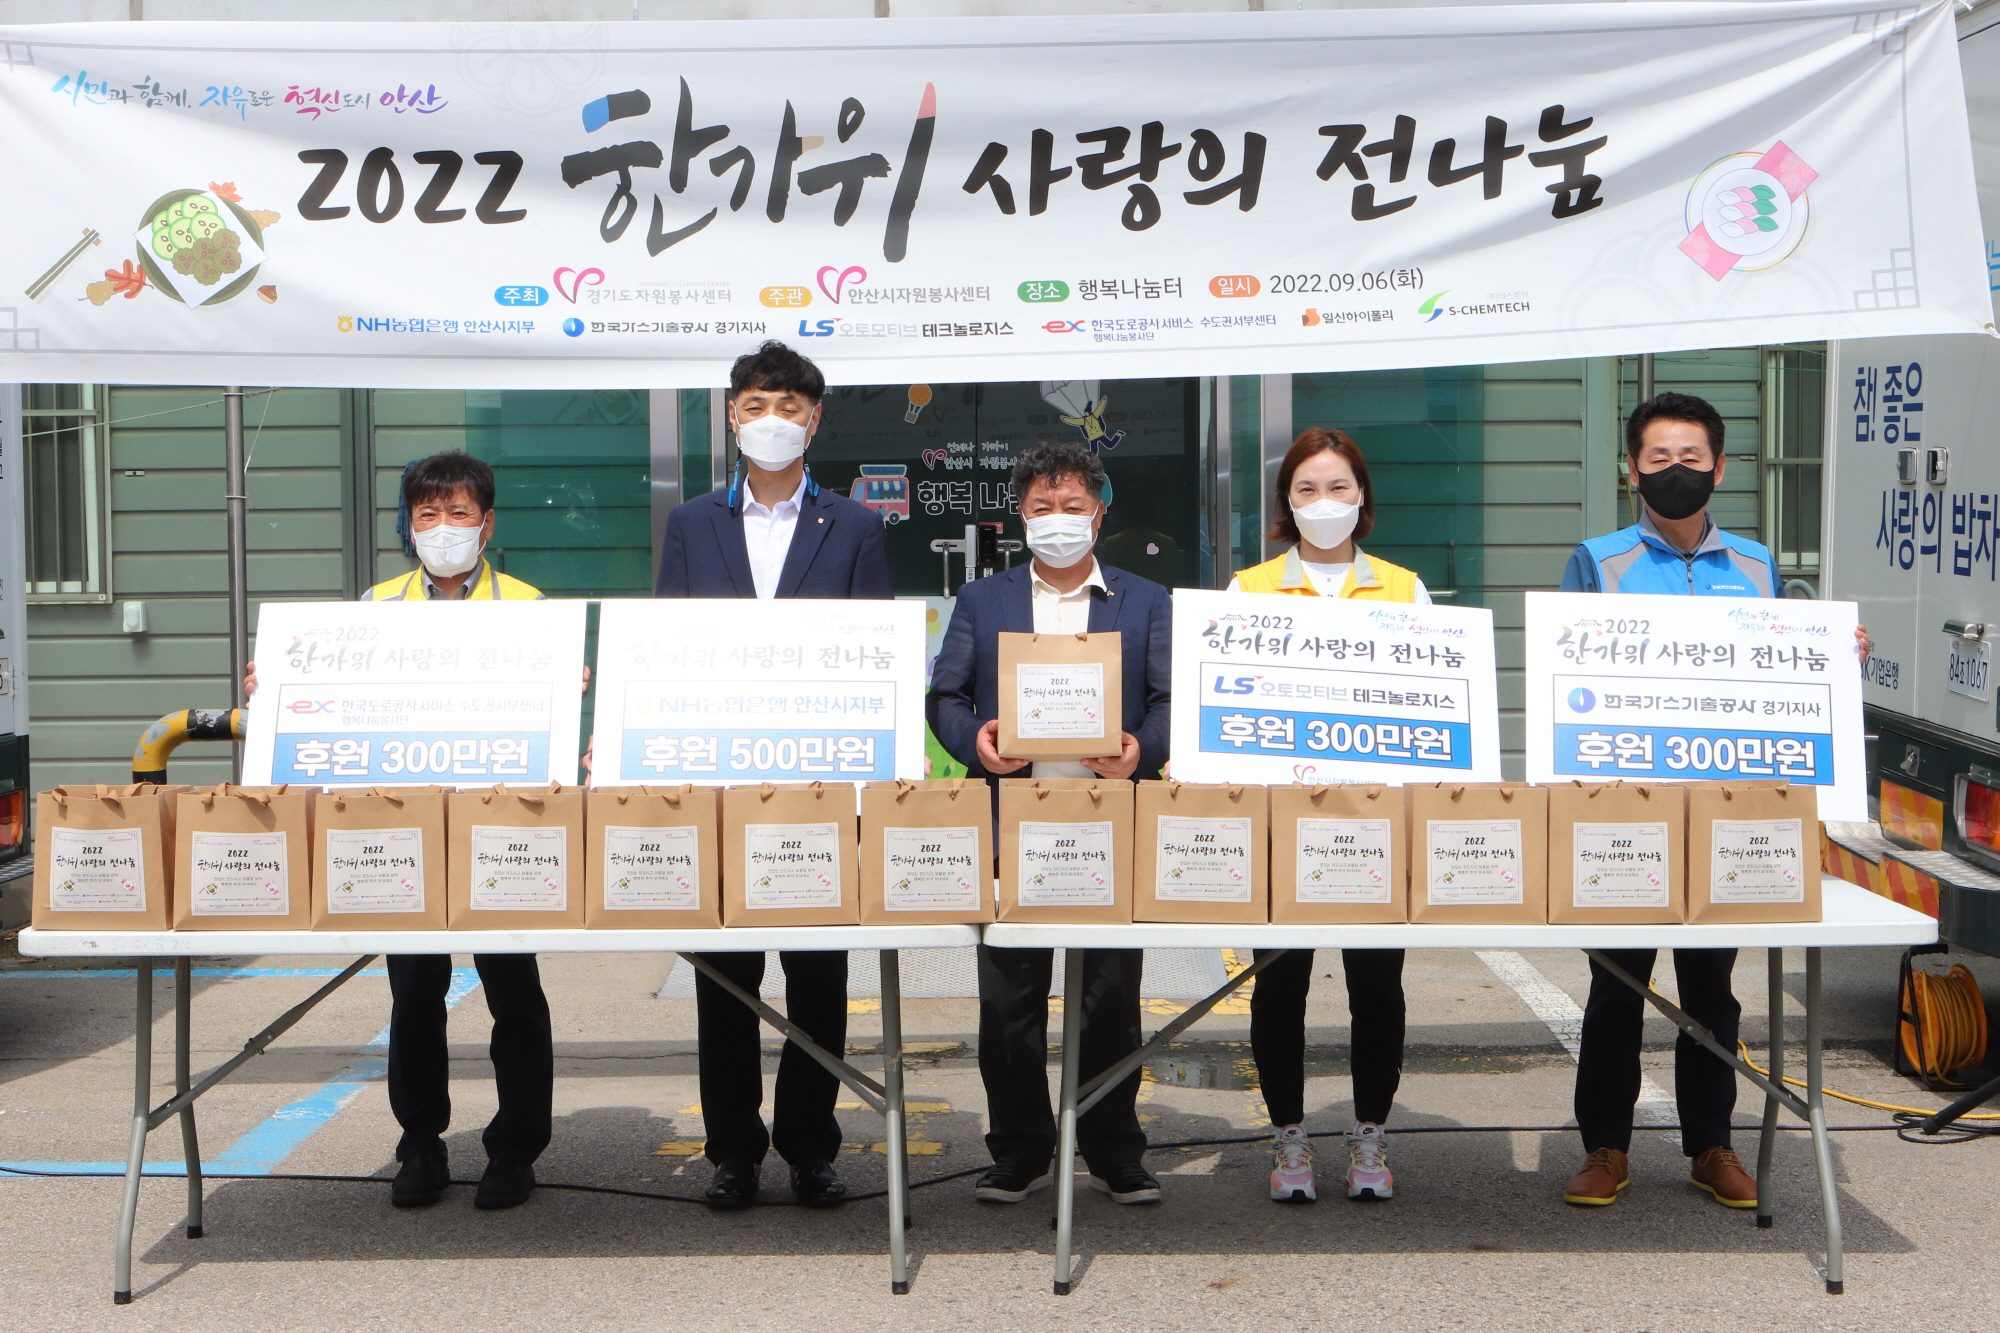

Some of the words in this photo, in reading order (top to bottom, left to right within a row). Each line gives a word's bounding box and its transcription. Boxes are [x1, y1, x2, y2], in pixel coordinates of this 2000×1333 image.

[51, 70, 132, 106] 시민과
[200, 85, 275, 121] 자유로운
[284, 85, 370, 121] 혁신도시
[379, 83, 449, 114] 안산
[297, 146, 527, 224] 2022
[561, 75, 936, 263] 한가위
[962, 120, 1267, 232] 사랑의
[1315, 104, 1608, 221] 전나눔
[503, 288, 540, 305] 주최
[586, 287, 732, 305] 경기도자원봉사센터
[767, 288, 804, 306] 주관
[847, 285, 991, 305] 안산시자원봉사센터
[1027, 281, 1062, 300] 장소
[1078, 277, 1183, 301] 행복나눔터
[1217, 278, 1252, 296] 일시
[1269, 267, 1425, 294] 2022.09.06(화)
[357, 317, 458, 334] NH농협은행
[463, 320, 536, 335] 안산시지부
[590, 321, 708, 334] 한국가스기술공사
[715, 320, 767, 335] 경기지사
[839, 322, 918, 338] 오토모티브
[922, 321, 1014, 338] 테크놀로지스
[1200, 314, 1277, 329] 수도권서부센터
[1322, 309, 1394, 326] 일신하이폴리
[1448, 301, 1531, 317] S-CHEMTECH
[1093, 331, 1155, 343] 행복나눔봉사단
[1883, 362, 1923, 444] 좋은
[917, 480, 973, 515] 행복
[1876, 488, 1943, 574] 사랑의
[1952, 492, 2000, 582] 밥차
[1250, 614, 1293, 630] 2022
[1605, 618, 1651, 635] 2022
[336, 627, 380, 642] 2022
[1202, 619, 1293, 656] 한가위
[1299, 637, 1375, 662] 사랑의
[1388, 642, 1467, 669] 전나눔
[1556, 626, 1650, 666] 한가위
[1656, 641, 1735, 668] 사랑의
[1749, 645, 1830, 672] 전나눔
[285, 636, 378, 674] 한가위
[383, 647, 460, 672] 사랑의
[726, 644, 803, 669] 사랑의
[817, 645, 895, 671] 전나눔
[1260, 682, 1348, 701] 오토모티브
[1353, 688, 1456, 709] 테크놀로지스
[459, 699, 544, 713] 수도권서부센터
[659, 695, 787, 714] NH농협은행
[794, 695, 886, 714] 안산시지부
[1604, 693, 1757, 714] 한국가스기술공사
[1762, 700, 1822, 718] 경기지사
[1219, 713, 1296, 751] 후원
[1306, 719, 1453, 761] 300만원
[293, 738, 372, 778] 후원
[380, 738, 530, 777] 300만원
[641, 735, 719, 774] 후원
[728, 736, 876, 774] 500만원
[1576, 731, 1654, 770] 후원
[1664, 736, 1816, 777] 300만원
[781, 841, 801, 849] 2022
[1055, 839, 1075, 847] 2022
[1195, 834, 1215, 842] 2022
[1465, 837, 1485, 845] 2022
[1612, 840, 1632, 848] 2022
[921, 844, 941, 852] 2022
[1191, 846, 1216, 855] 사랑의
[1221, 846, 1244, 856] 전나눔
[1331, 848, 1356, 857] 사랑의
[1360, 848, 1384, 858] 전나눔
[1462, 849, 1487, 858] 사랑의
[1491, 848, 1515, 859] 전나눔
[1746, 850, 1770, 859] 사랑의
[1774, 848, 1796, 858] 전나눔
[80, 859, 105, 867] 사랑의
[110, 858, 135, 867] 전나눔
[360, 858, 386, 867] 사랑의
[391, 857, 415, 867] 전나눔
[505, 856, 530, 865] 사랑의
[535, 855, 559, 866] 전나눔
[637, 856, 662, 864] 사랑의
[667, 855, 691, 865] 전나눔
[778, 854, 803, 863] 사랑의
[808, 853, 832, 863] 전나눔
[918, 856, 943, 865] 사랑의
[947, 856, 971, 866] 전나눔
[1052, 852, 1077, 860] 사랑의
[1082, 851, 1106, 861] 전나눔
[1608, 852, 1633, 861] 사랑의
[1638, 851, 1661, 863] 전나눔
[225, 862, 250, 871] 사랑의
[255, 861, 280, 871] 전나눔
